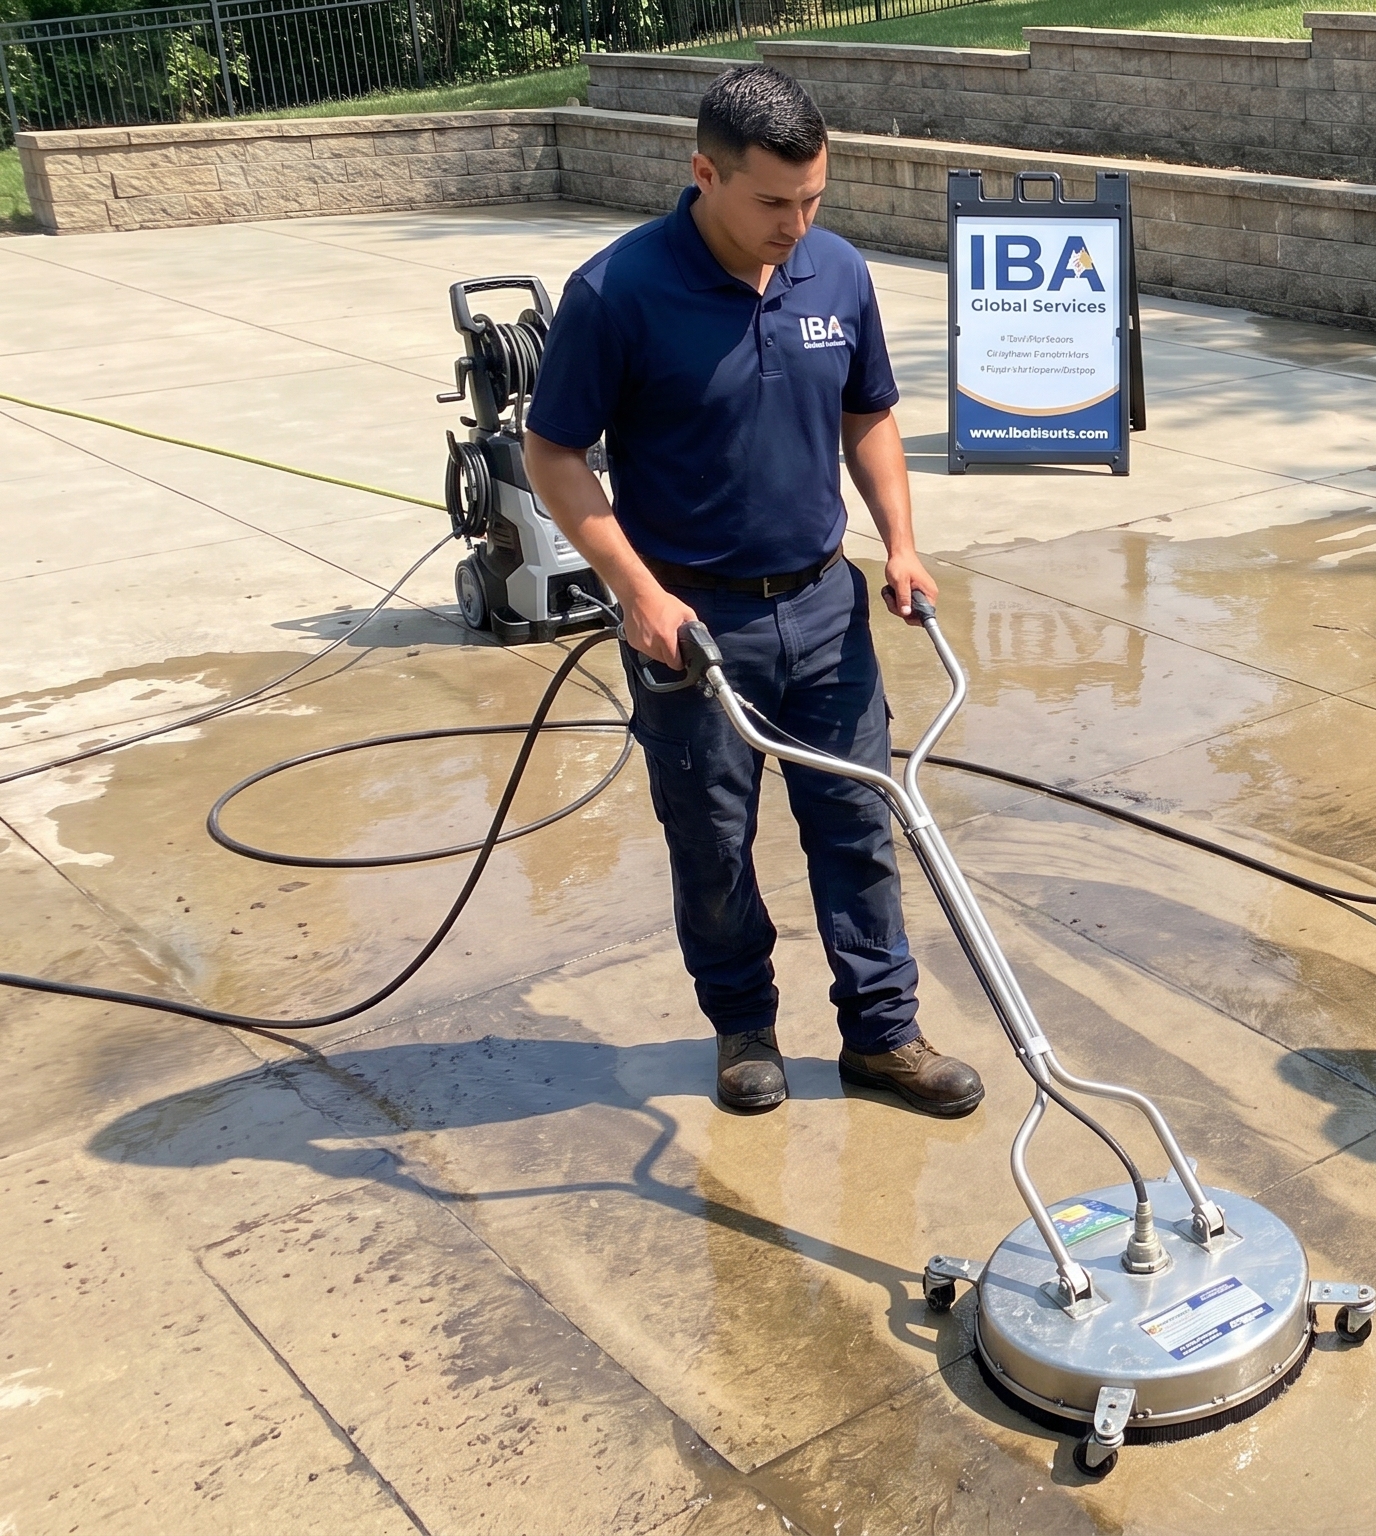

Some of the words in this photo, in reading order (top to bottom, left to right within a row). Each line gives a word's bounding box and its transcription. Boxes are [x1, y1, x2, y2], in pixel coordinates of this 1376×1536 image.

[970, 234, 1106, 292] IBA
[971, 298, 1027, 312] Global
[1032, 298, 1106, 313] Services
[799, 315, 844, 341] IBA
